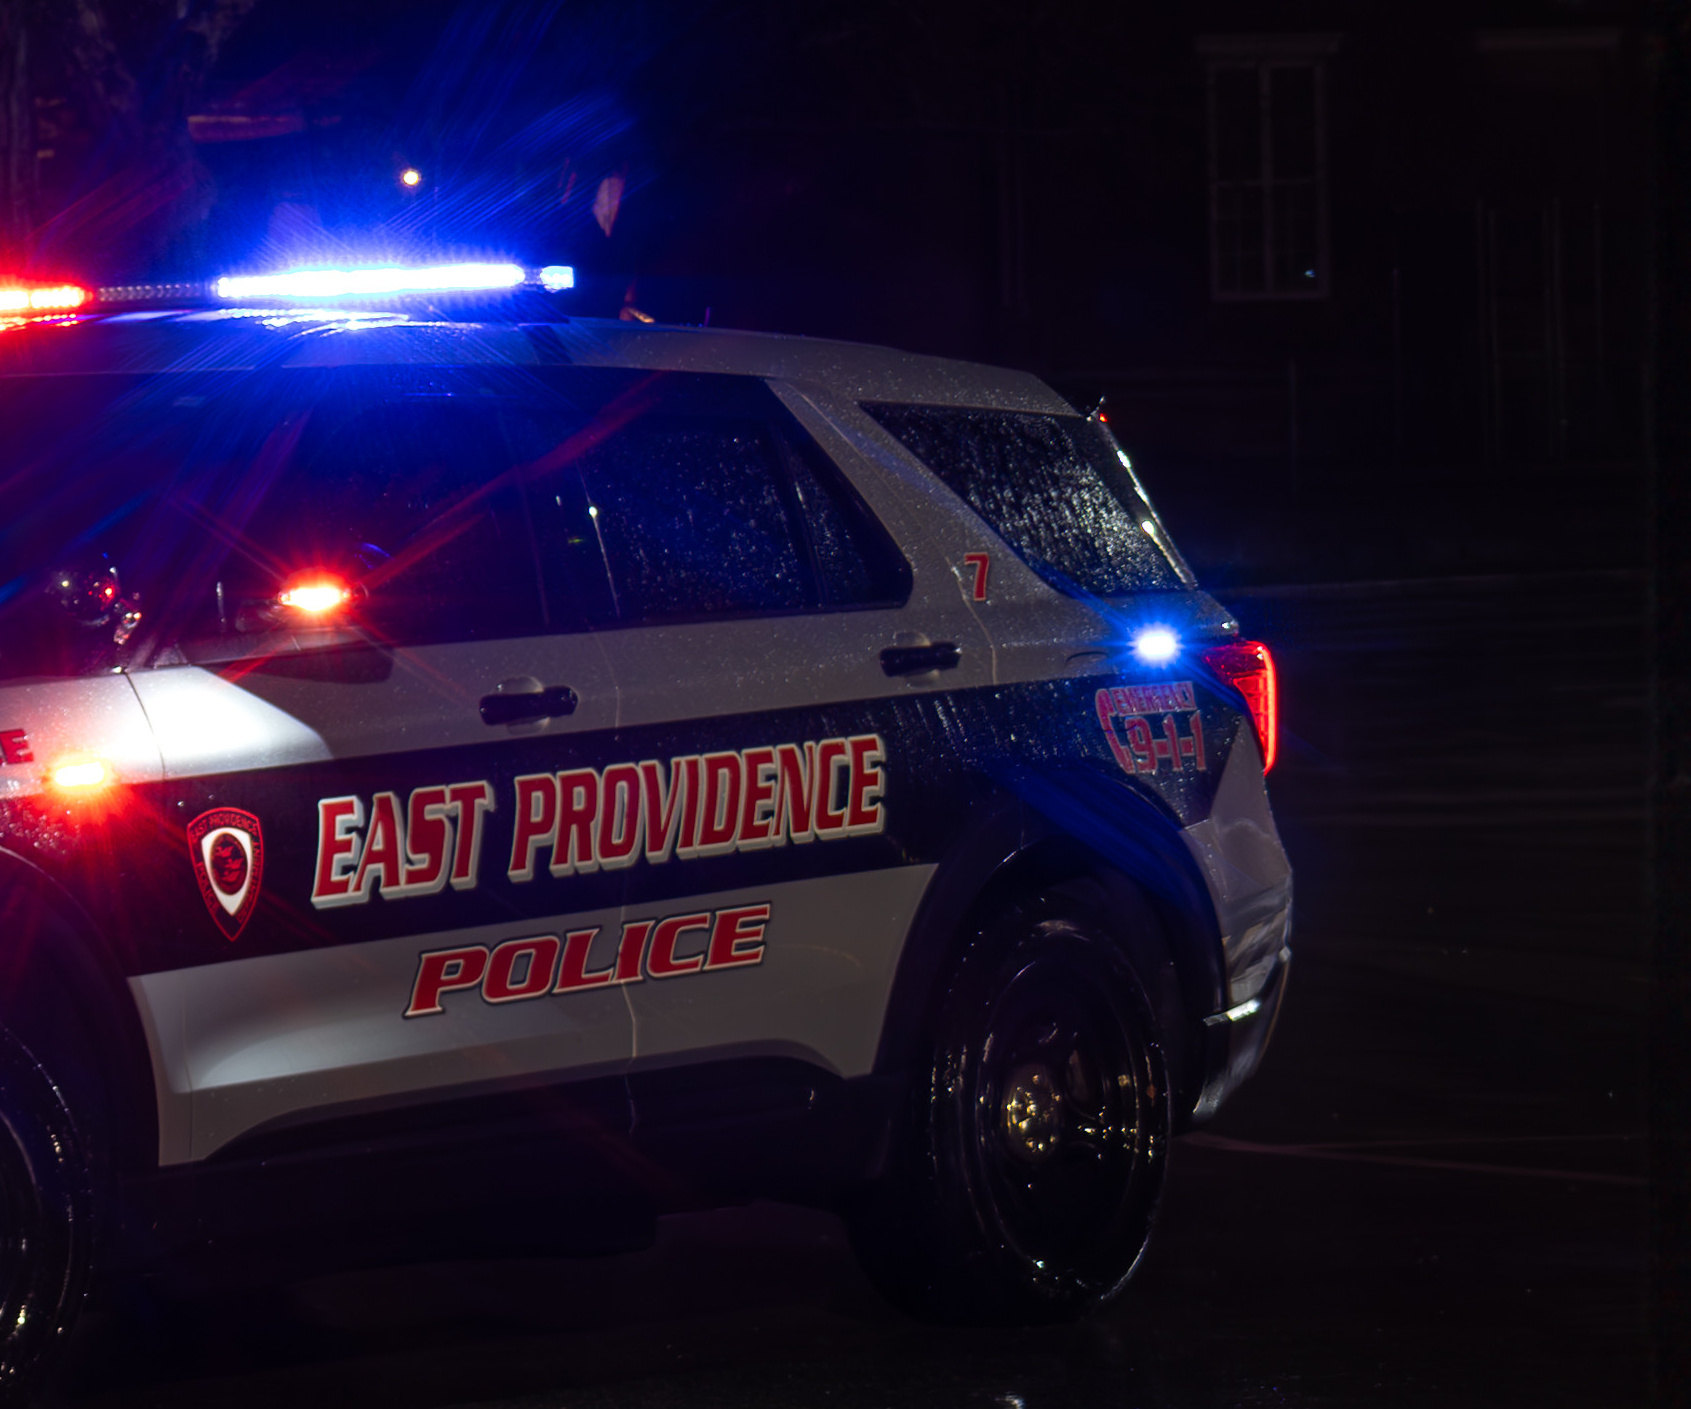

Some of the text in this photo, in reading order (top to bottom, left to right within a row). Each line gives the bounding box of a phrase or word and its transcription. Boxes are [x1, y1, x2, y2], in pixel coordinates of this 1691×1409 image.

[964, 552, 990, 601] 7
[1124, 710, 1206, 773] 9-1-1
[311, 733, 885, 910] EAST PROVIDENCE
[402, 901, 771, 1018] POLICE
